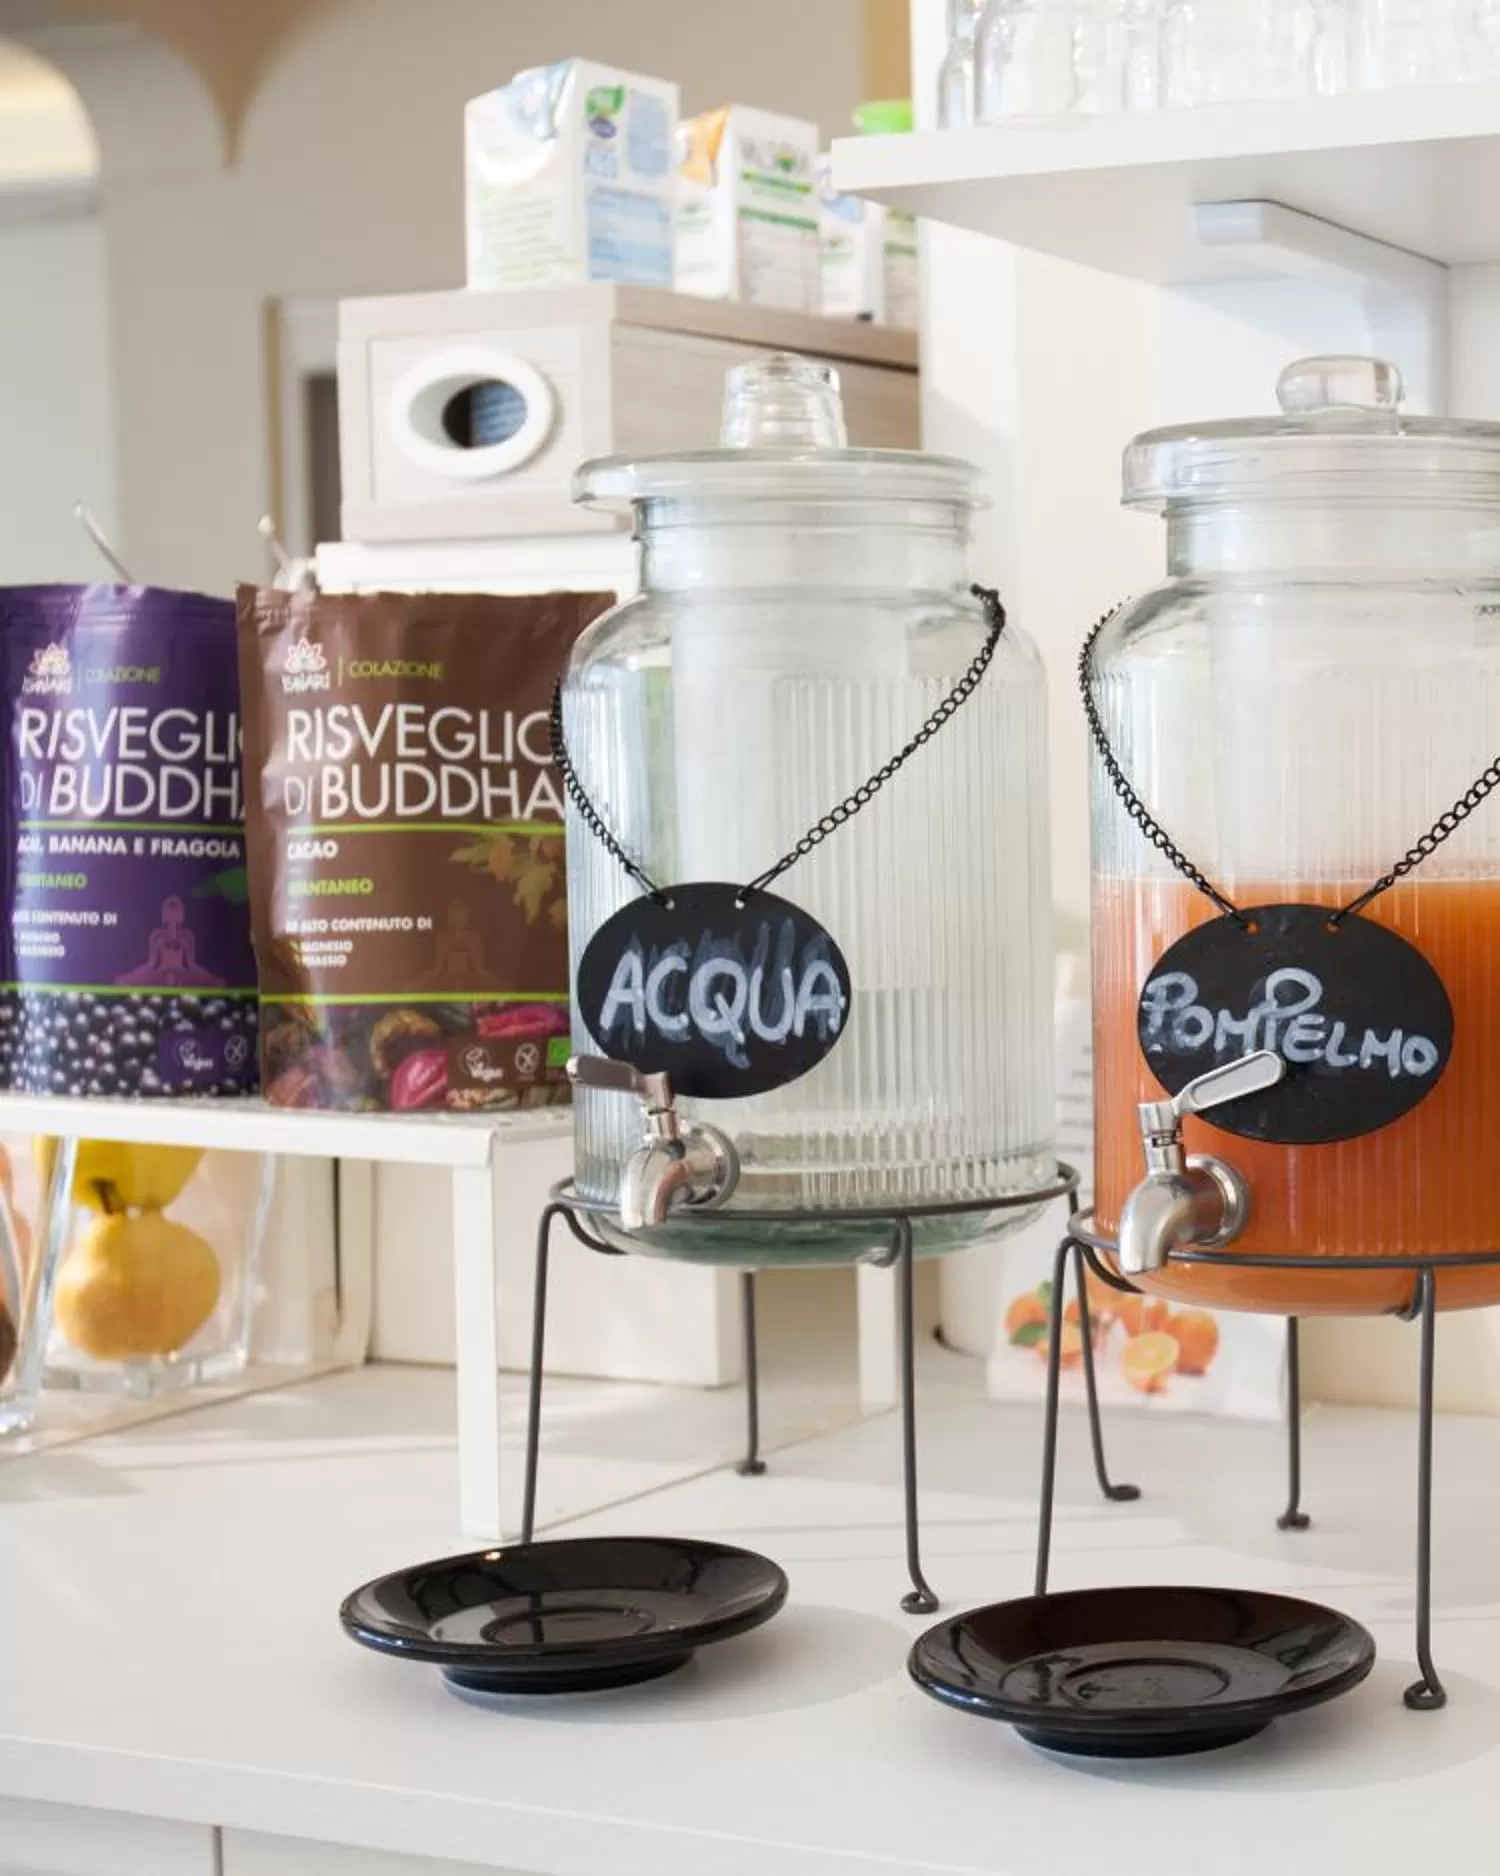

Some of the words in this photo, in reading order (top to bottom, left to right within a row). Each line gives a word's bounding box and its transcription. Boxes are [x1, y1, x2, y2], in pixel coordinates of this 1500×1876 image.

[20, 706, 244, 763] RISVEGLI
[20, 771, 43, 811] DI
[49, 763, 245, 819] BUDDH
[284, 775, 313, 816] DI
[320, 762, 566, 820] BUDDHA
[50, 834, 127, 856] BANANA
[133, 837, 145, 855] E
[151, 838, 240, 859] FRAGOLA
[331, 916, 413, 932] CONTENUTO
[417, 917, 432, 930] DI
[600, 950, 845, 1045] ACQUA
